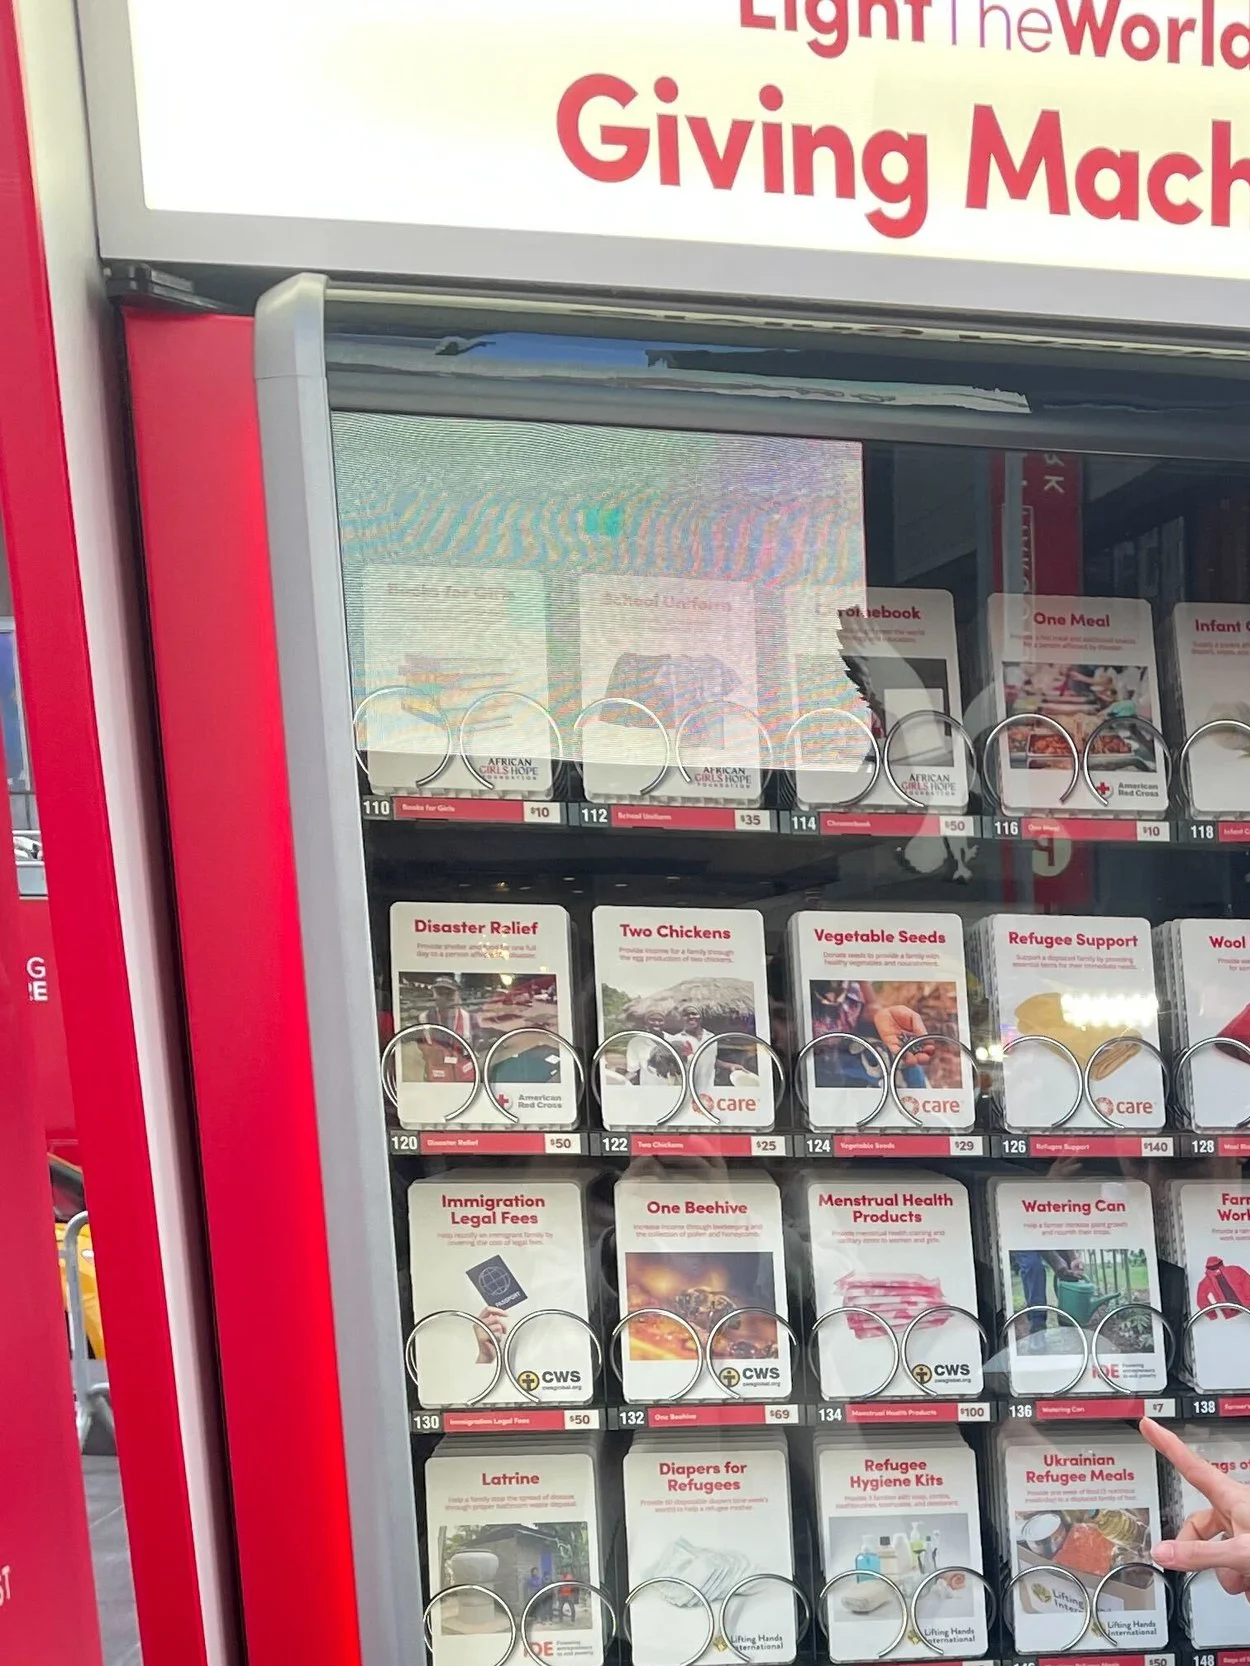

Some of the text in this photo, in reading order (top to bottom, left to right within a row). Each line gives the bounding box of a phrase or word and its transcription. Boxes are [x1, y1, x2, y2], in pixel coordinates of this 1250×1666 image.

[556, 73, 928, 239] Giving
[1034, 611, 1110, 628] One Meal
[1195, 618, 1242, 633] Infant
[487, 757, 533, 767] AFRICAN
[511, 766, 539, 776] HOPE
[363, 801, 390, 815] 110
[581, 808, 608, 823] 112
[791, 815, 816, 831] 114
[994, 820, 1019, 836] 116
[1190, 824, 1214, 839] 118
[414, 919, 539, 936] Disaster Relief
[619, 923, 732, 941] Two Chickens
[813, 928, 946, 948] Vegetable Seeds
[1008, 931, 1138, 950] Refugee Support
[1209, 935, 1246, 949] Wool
[716, 1096, 757, 1113] care
[921, 1097, 961, 1114] care
[391, 1136, 418, 1151] 120
[549, 1137, 572, 1149] $50
[602, 1136, 628, 1152] 122
[756, 1140, 777, 1152] $25
[806, 1139, 831, 1153] 124
[954, 1140, 975, 1152] $29
[1002, 1139, 1027, 1153] 126
[1143, 1141, 1168, 1153] $140
[1191, 1139, 1215, 1153] 128
[442, 1194, 545, 1211] Immigration
[647, 1200, 748, 1215] One Beehive
[818, 1193, 954, 1208] Menstrual Health
[1022, 1199, 1126, 1216] Watering Can
[451, 1211, 538, 1229] Legal Fees
[853, 1210, 922, 1224] Products
[542, 1370, 581, 1384] CWS
[743, 1367, 780, 1380] CWS
[770, 1409, 790, 1420] $69
[818, 1408, 842, 1422] 134
[960, 1407, 985, 1418] $100
[1008, 1404, 1032, 1418] 136
[1193, 1401, 1215, 1414] 138
[413, 1415, 440, 1430] 130
[569, 1413, 591, 1426] $50
[619, 1410, 645, 1426] 132
[864, 1459, 927, 1475] Refugee
[1043, 1454, 1115, 1468] Ukrainian
[659, 1461, 748, 1478] Diapers for
[482, 1472, 540, 1487] Latrine
[850, 1474, 944, 1492] Hygiene Kits
[1026, 1469, 1135, 1486] Refugee Meals
[668, 1478, 741, 1493] Refugees
